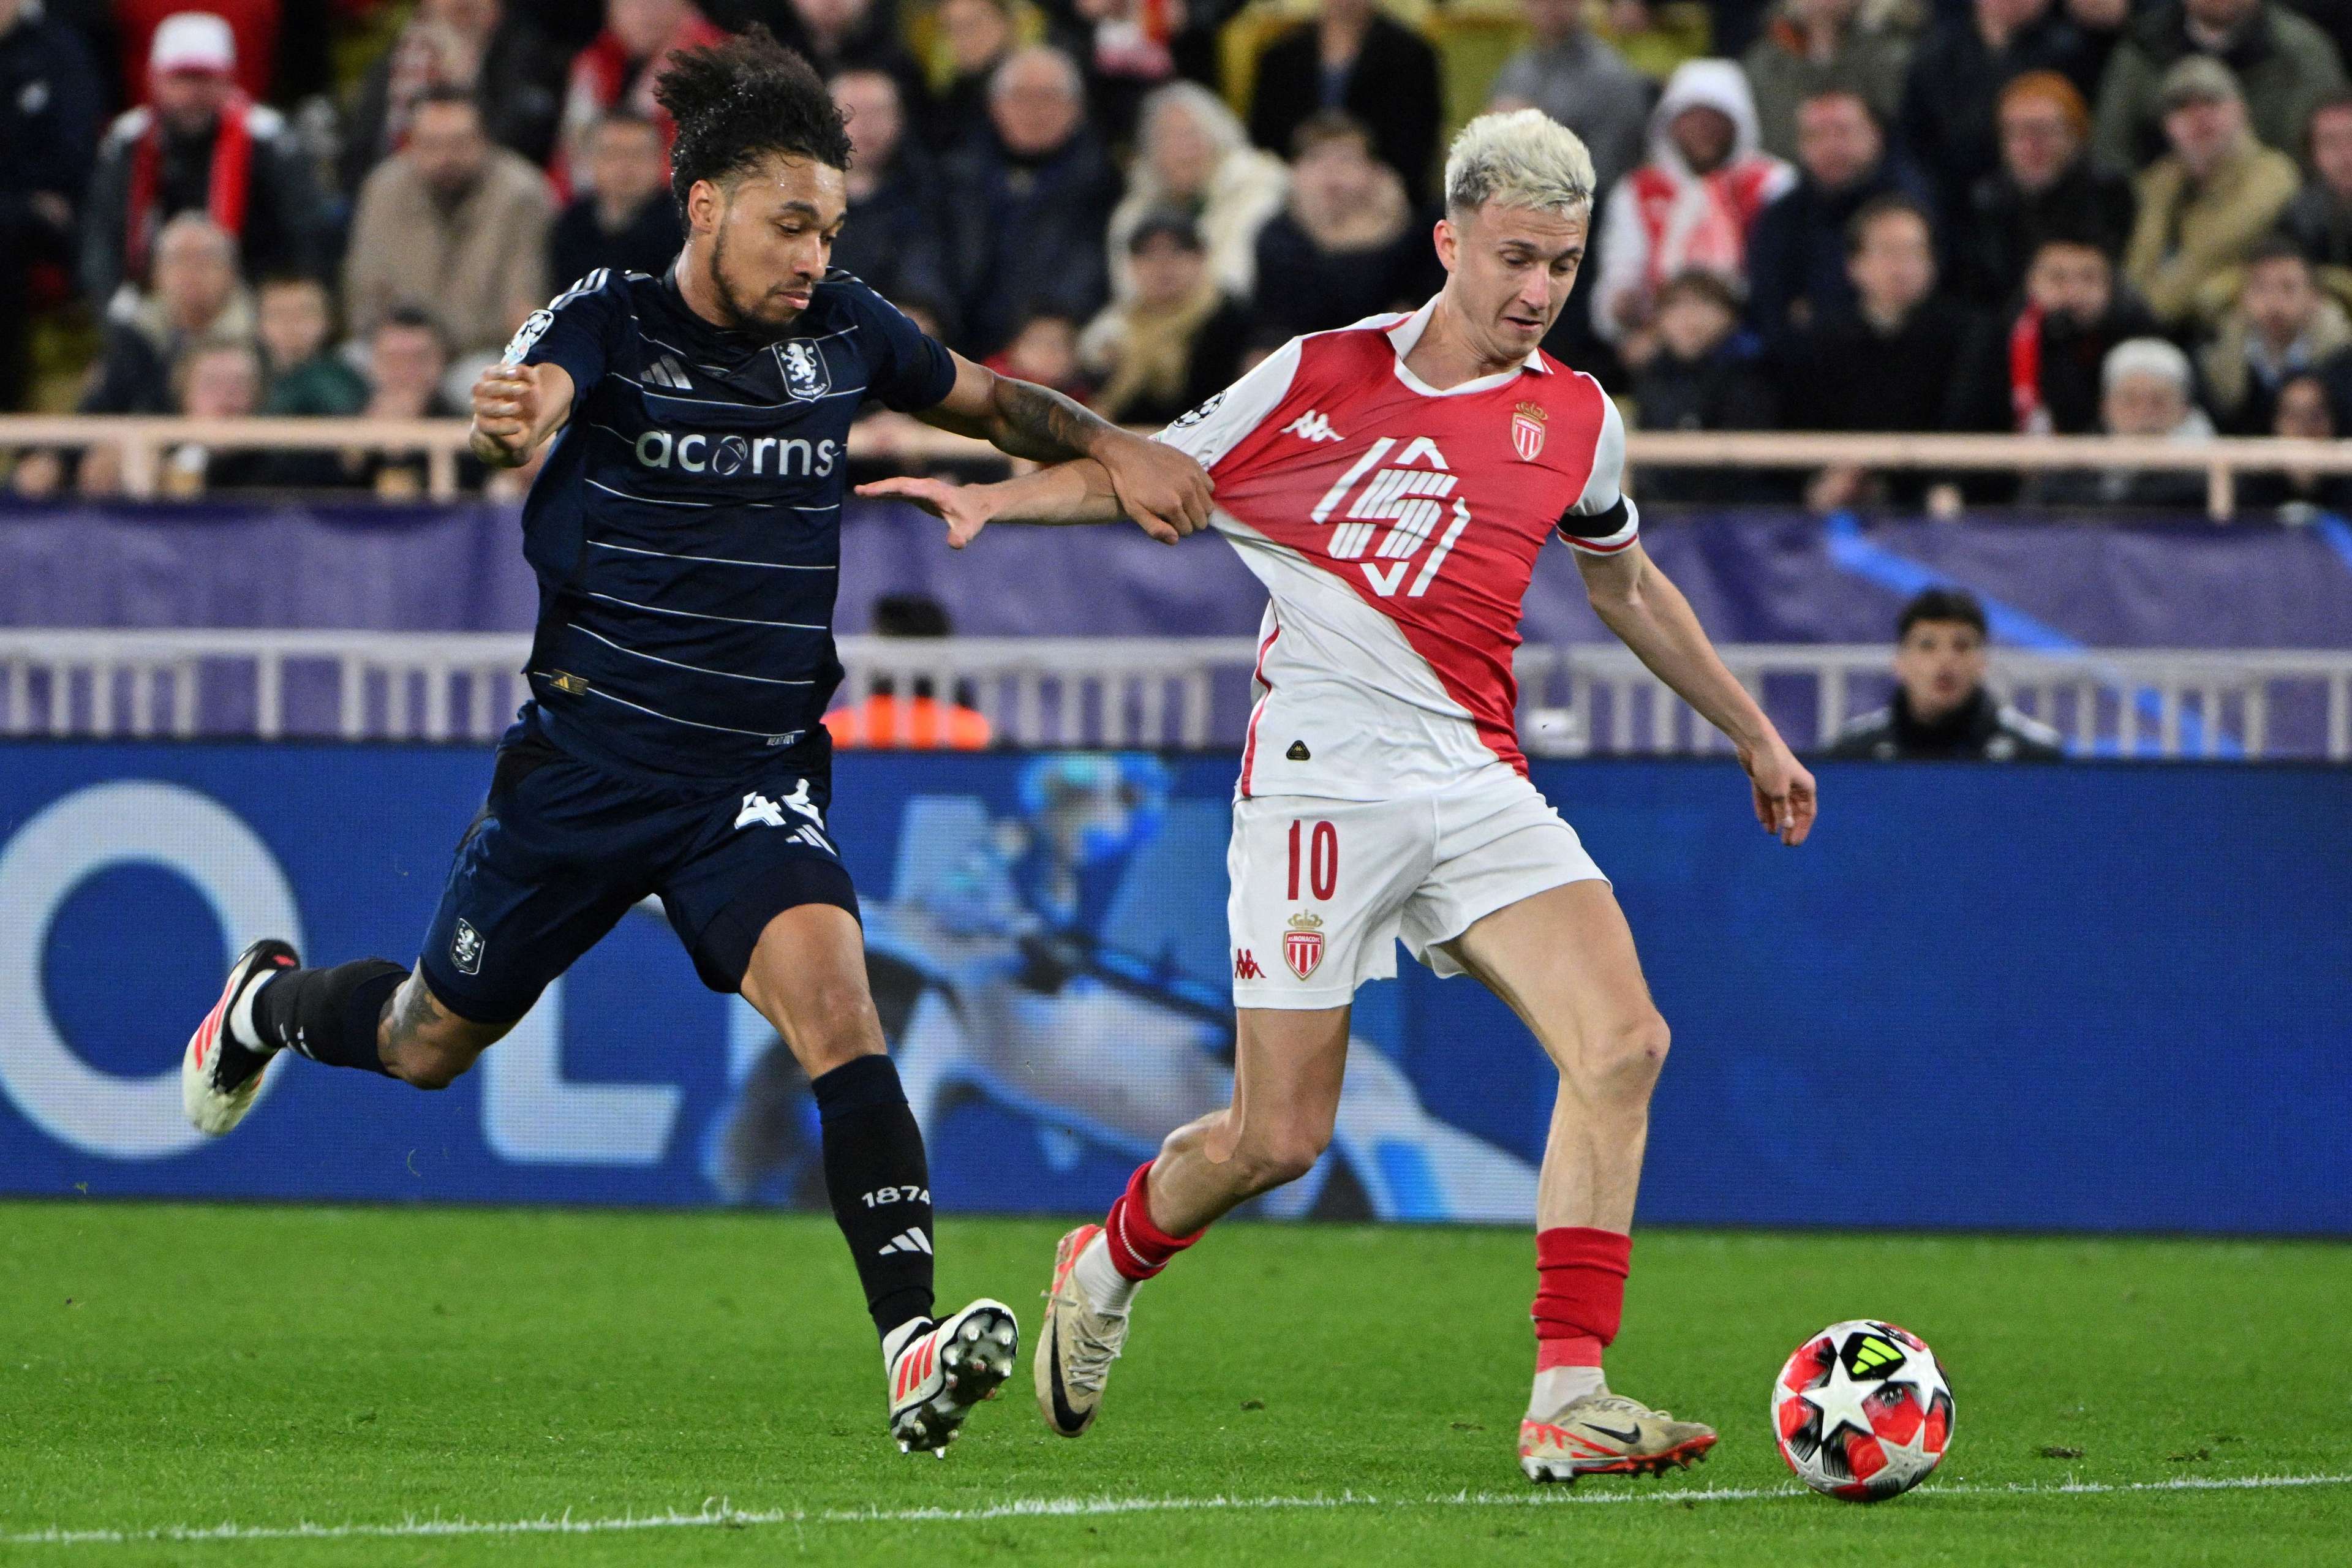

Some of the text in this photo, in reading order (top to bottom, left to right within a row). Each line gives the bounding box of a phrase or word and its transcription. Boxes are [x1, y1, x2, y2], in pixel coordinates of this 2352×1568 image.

[636, 430, 835, 477] acorns
[1287, 819, 1338, 901] 10
[861, 1185, 931, 1208] 1874
